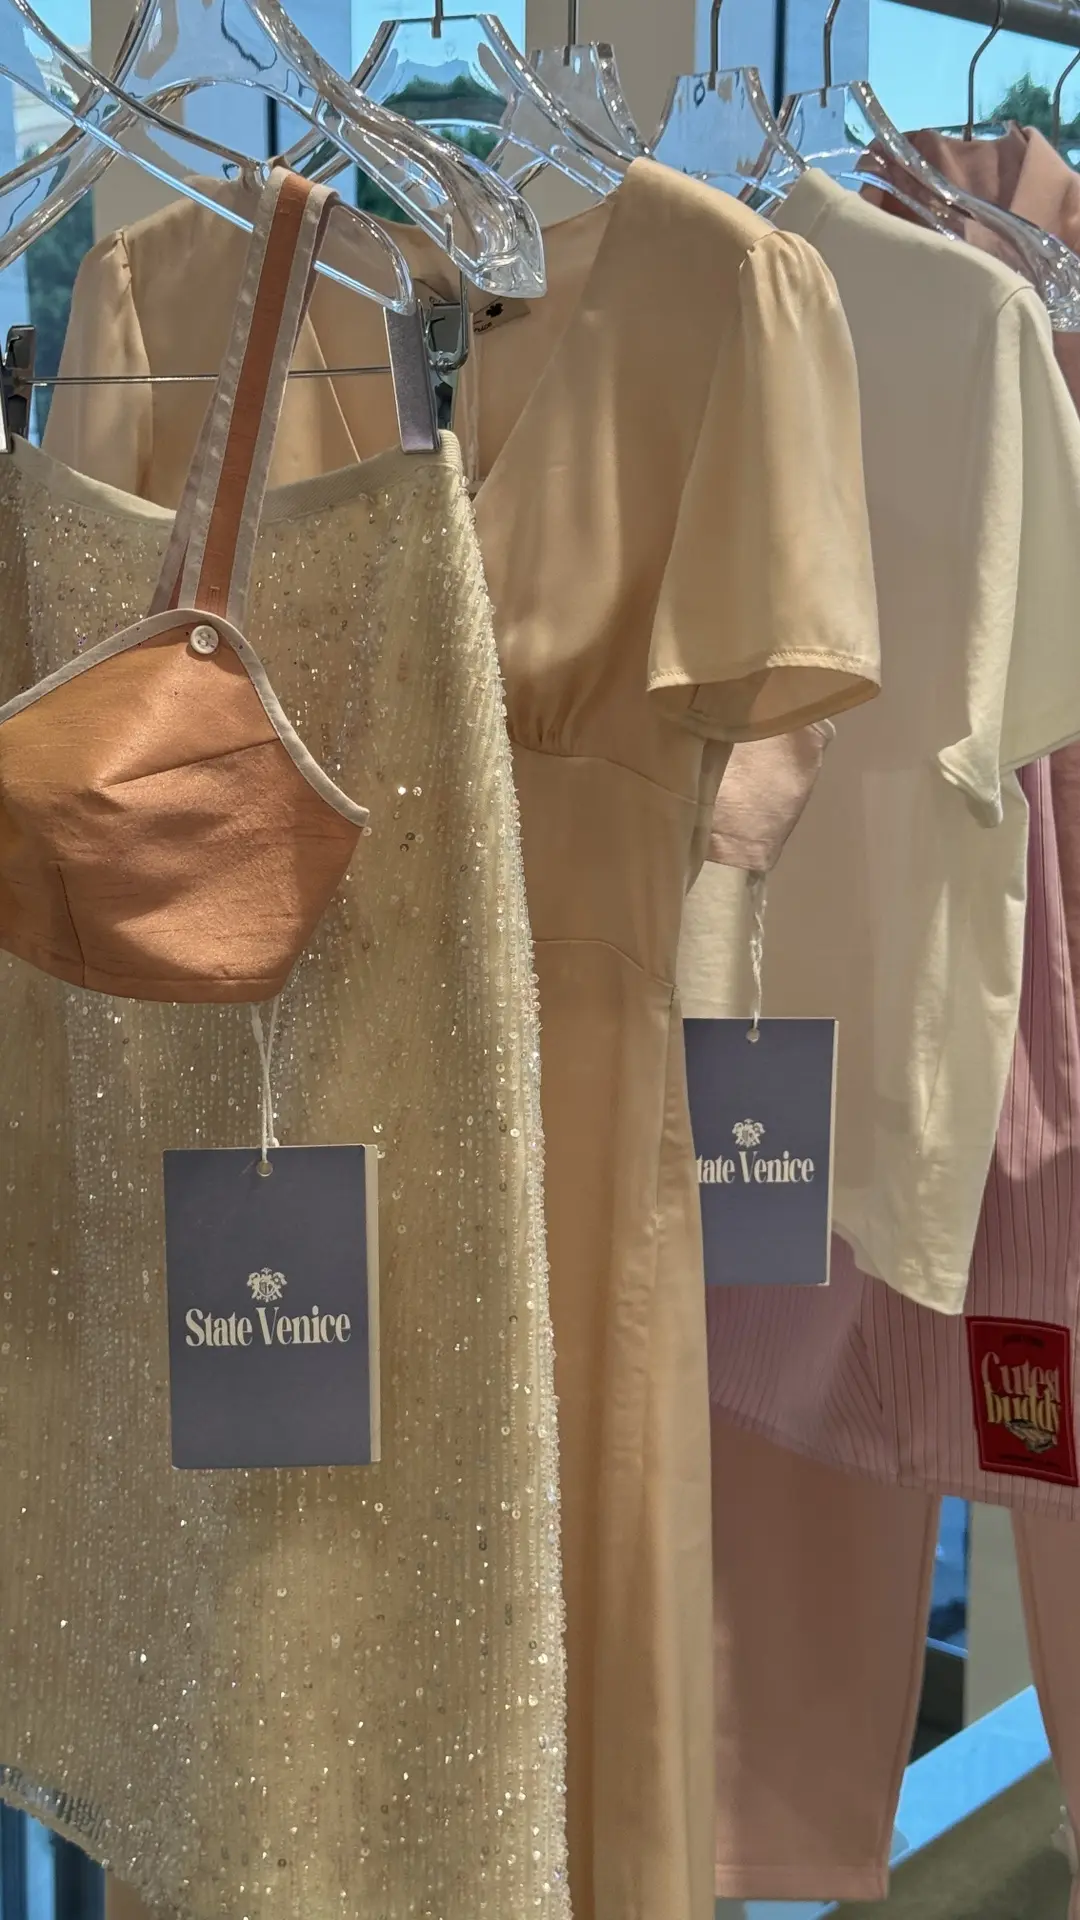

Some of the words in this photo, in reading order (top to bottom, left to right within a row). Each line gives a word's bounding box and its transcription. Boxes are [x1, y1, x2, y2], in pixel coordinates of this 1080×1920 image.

[695, 1154, 735, 1184] tate
[738, 1150, 815, 1184] Venice
[185, 1308, 253, 1347] State
[255, 1304, 351, 1345] Venice
